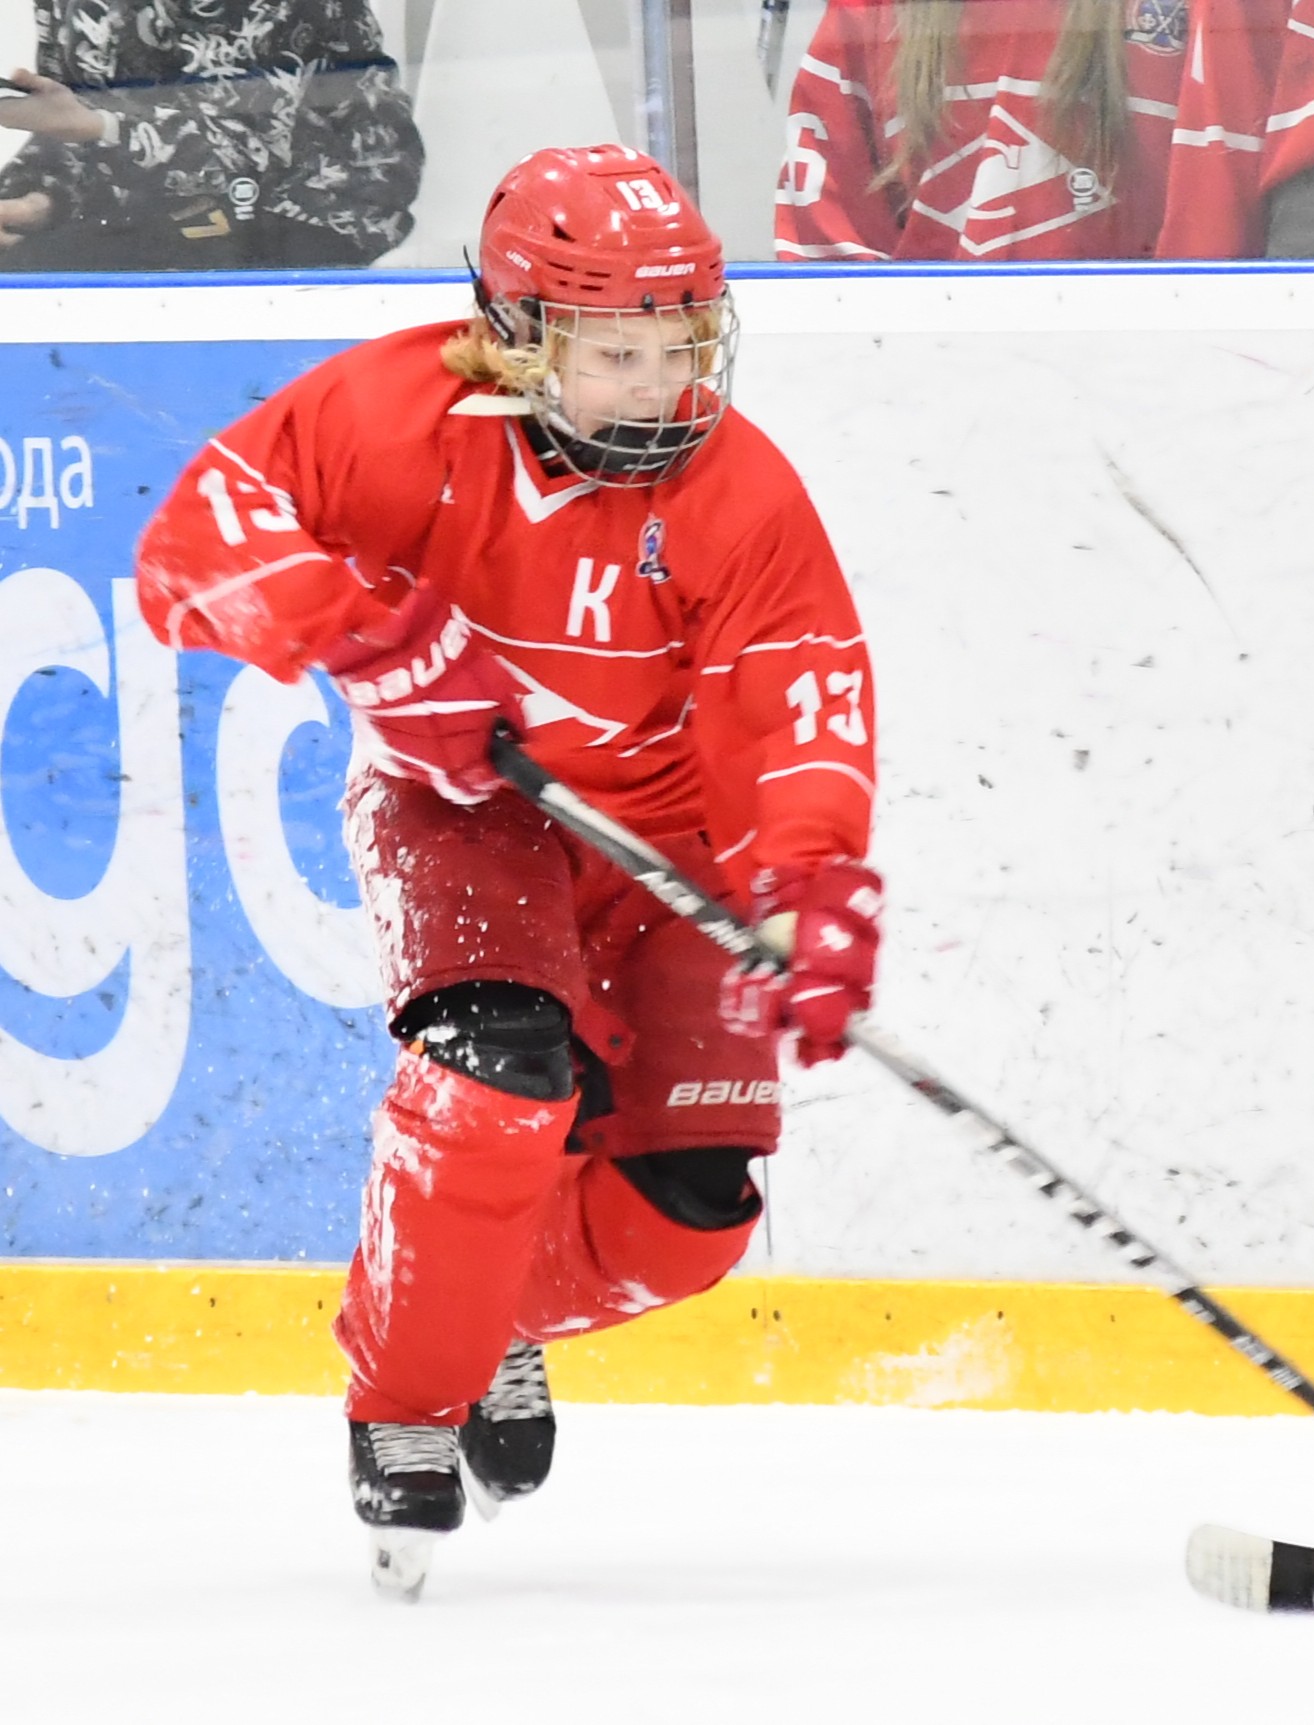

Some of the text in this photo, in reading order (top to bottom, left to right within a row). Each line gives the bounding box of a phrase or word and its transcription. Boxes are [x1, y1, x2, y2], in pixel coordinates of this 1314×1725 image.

[615, 178, 665, 212] 13
[344, 618, 472, 707] BAUE
[783, 668, 869, 748] 13
[666, 1080, 786, 1107] BAUE
